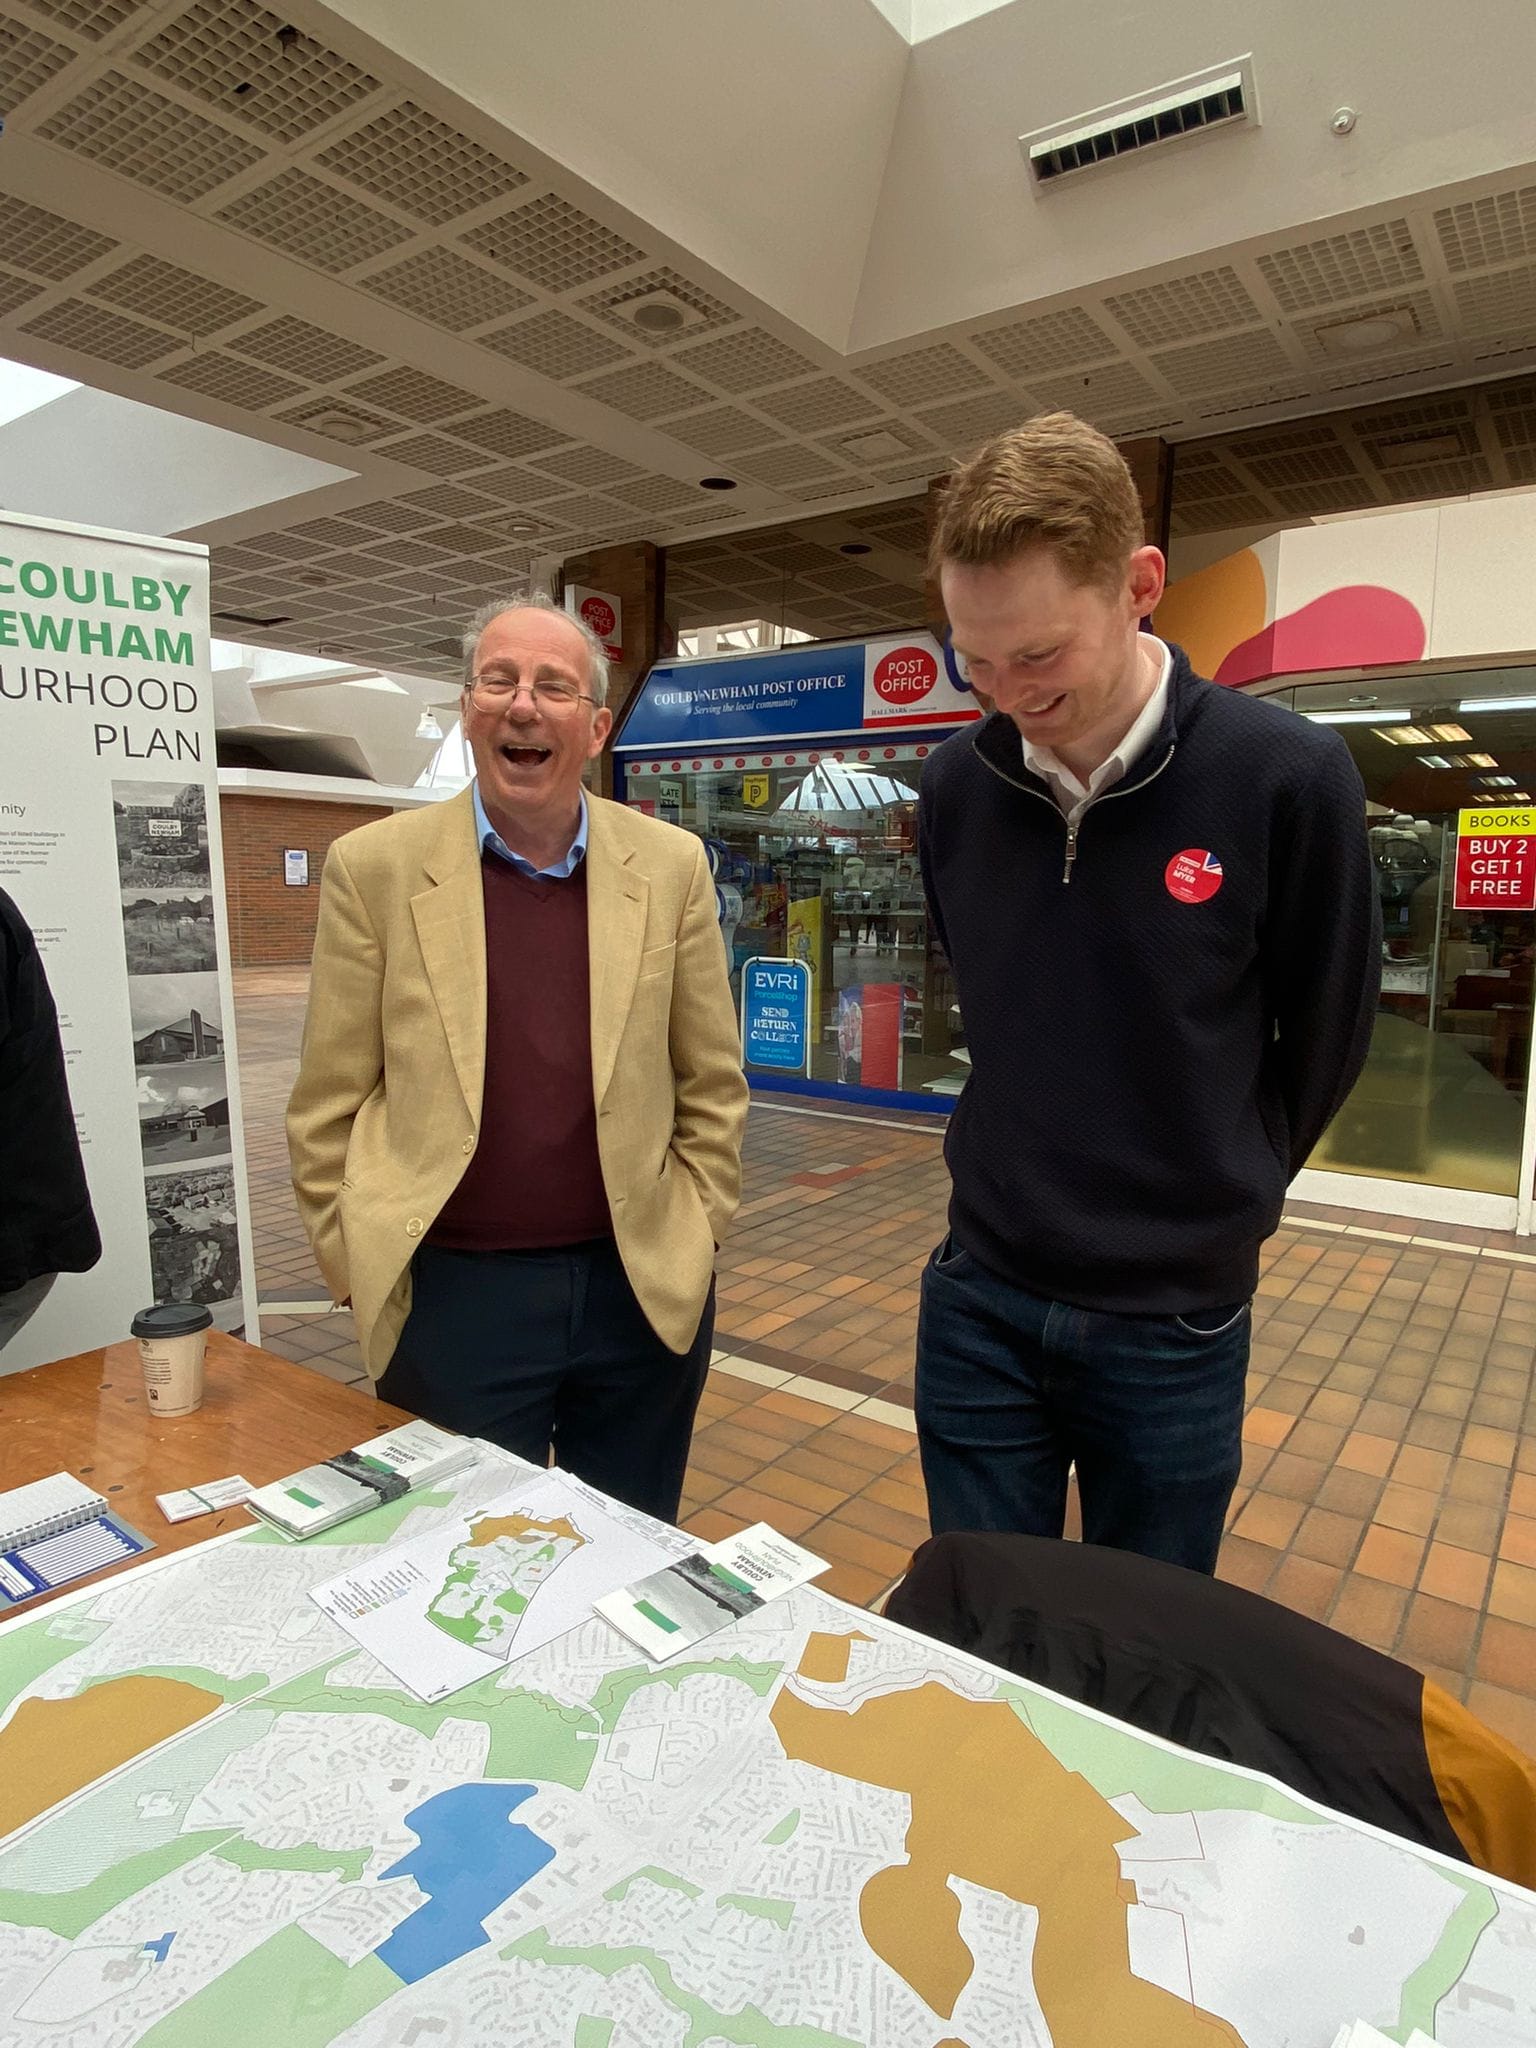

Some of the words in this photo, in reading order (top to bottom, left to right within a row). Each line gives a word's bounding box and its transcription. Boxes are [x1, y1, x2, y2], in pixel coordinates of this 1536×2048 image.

[588, 604, 609, 617] POST
[888, 659, 924, 676] POST
[654, 690, 700, 706] COULBY
[703, 684, 759, 700] NEWHAM
[762, 680, 795, 696] POST
[797, 674, 846, 692] OFFICE
[880, 675, 931, 693] OFFICE
[693, 705, 721, 716] Serving
[723, 702, 734, 713] the
[735, 700, 754, 712] local
[755, 698, 799, 711] community
[94, 723, 201, 762] PLAN
[1470, 814, 1531, 828] BOOKS
[1469, 839, 1512, 855] BUY
[1516, 839, 1528, 855] 2
[1470, 859, 1511, 875] GET
[1515, 859, 1523, 875] 1
[1469, 879, 1522, 895] FREE
[754, 971, 798, 990] EVRi
[761, 1006, 790, 1018] SEND
[753, 1018, 797, 1031] RETURN
[750, 1030, 800, 1044] COLLECT
[731, 1561, 763, 1582] COULBY
[737, 1554, 775, 1579] NEWHAM
